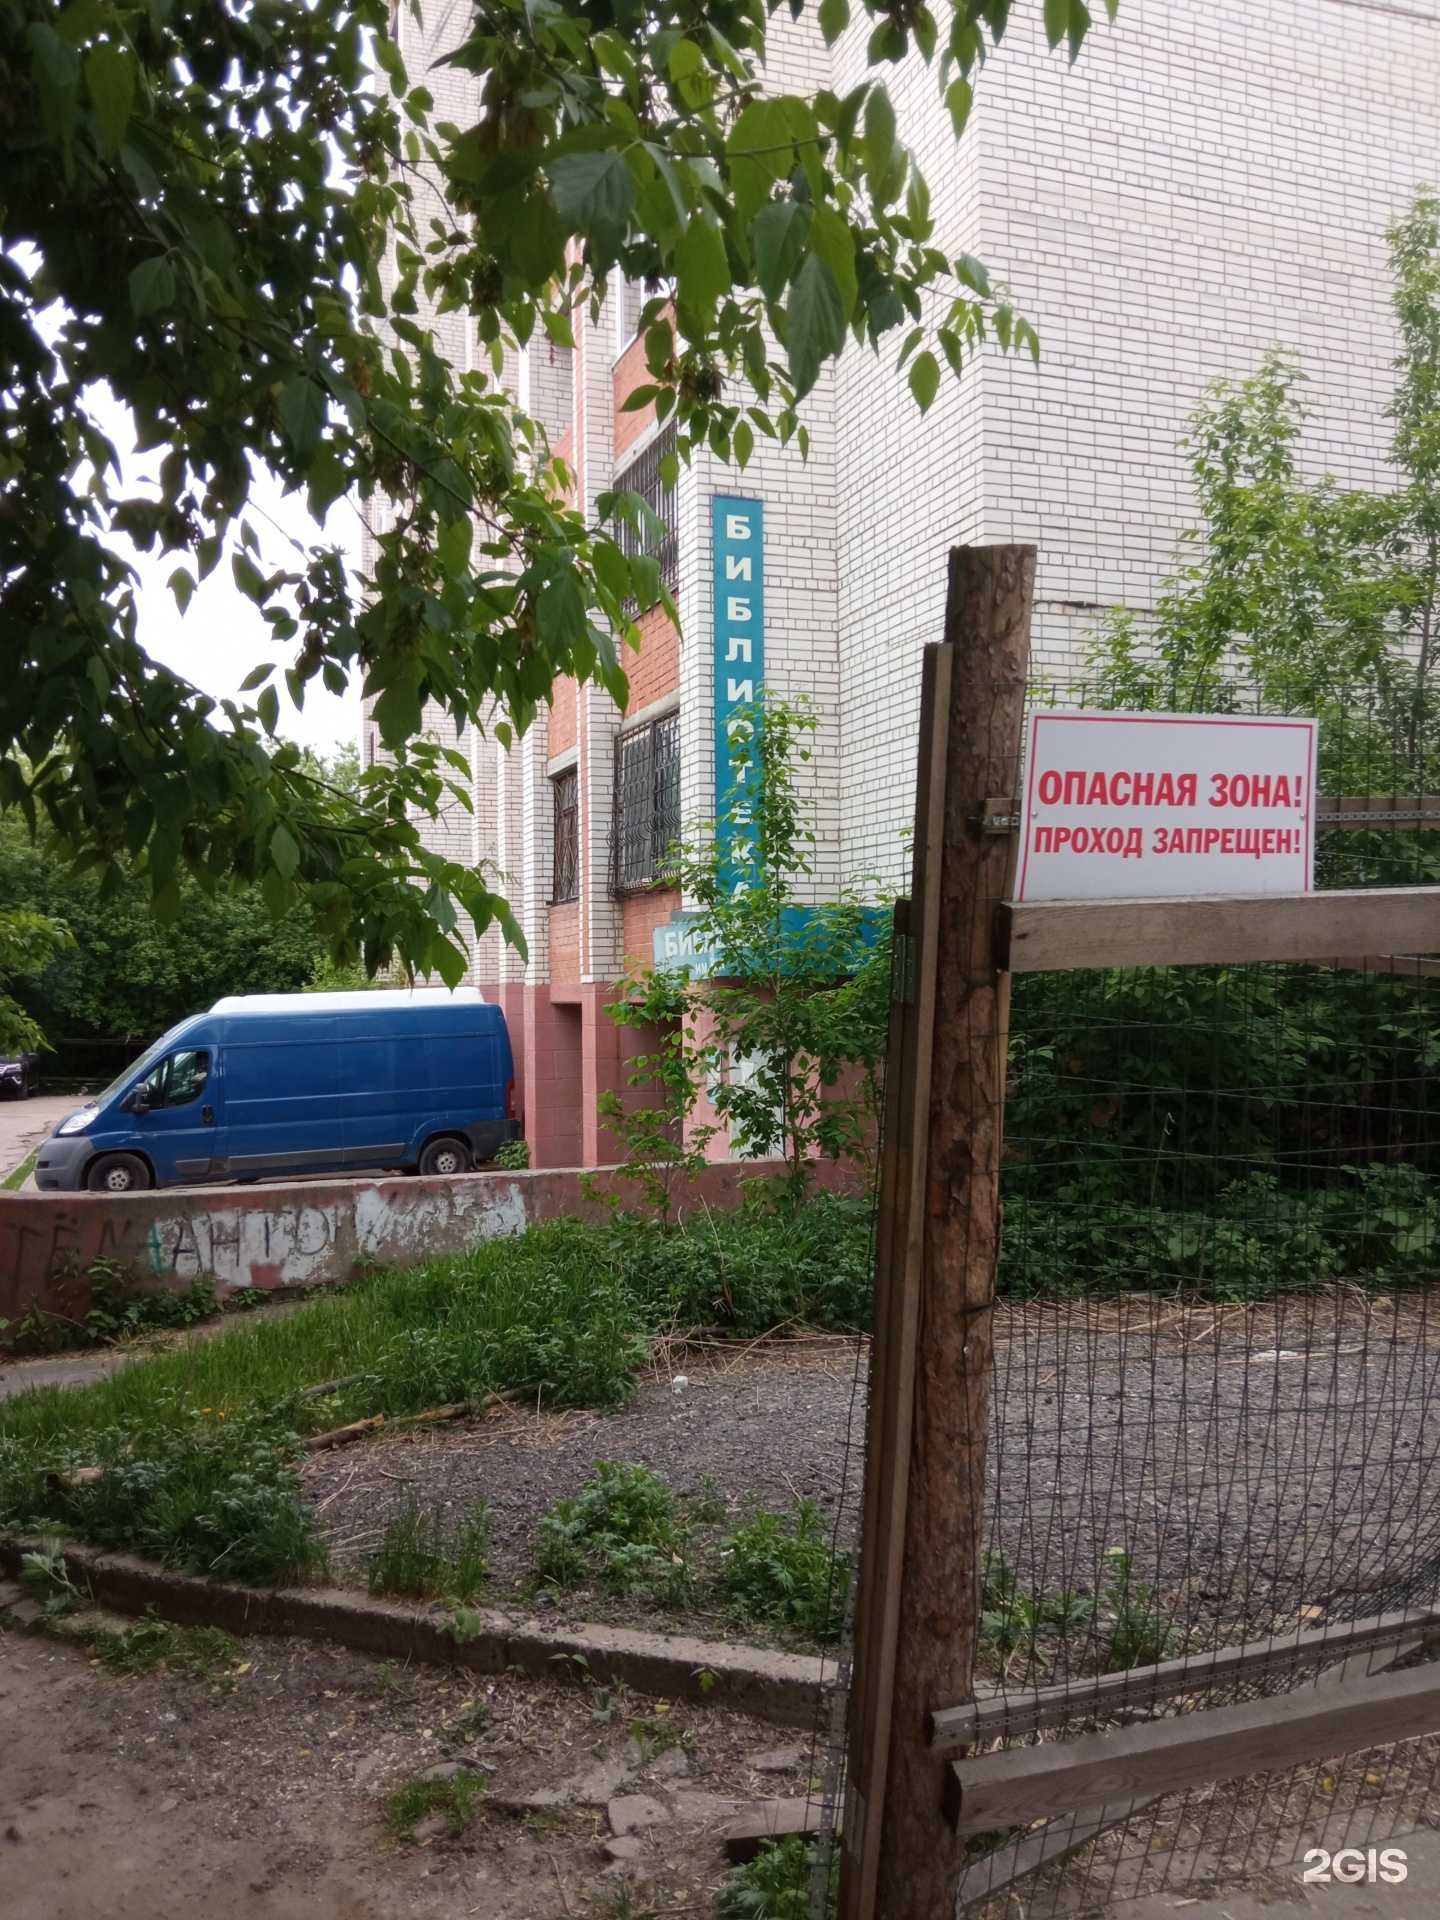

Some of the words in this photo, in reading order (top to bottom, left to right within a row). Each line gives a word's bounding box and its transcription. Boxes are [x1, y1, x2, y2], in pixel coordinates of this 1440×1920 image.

[1038, 771, 1198, 806] ОПАСНАЯ
[1208, 773, 1303, 808] ЗОНА!
[1034, 827, 1143, 859] ПРОХОД
[1152, 828, 1301, 859] ЗАПРЕЩЕН!
